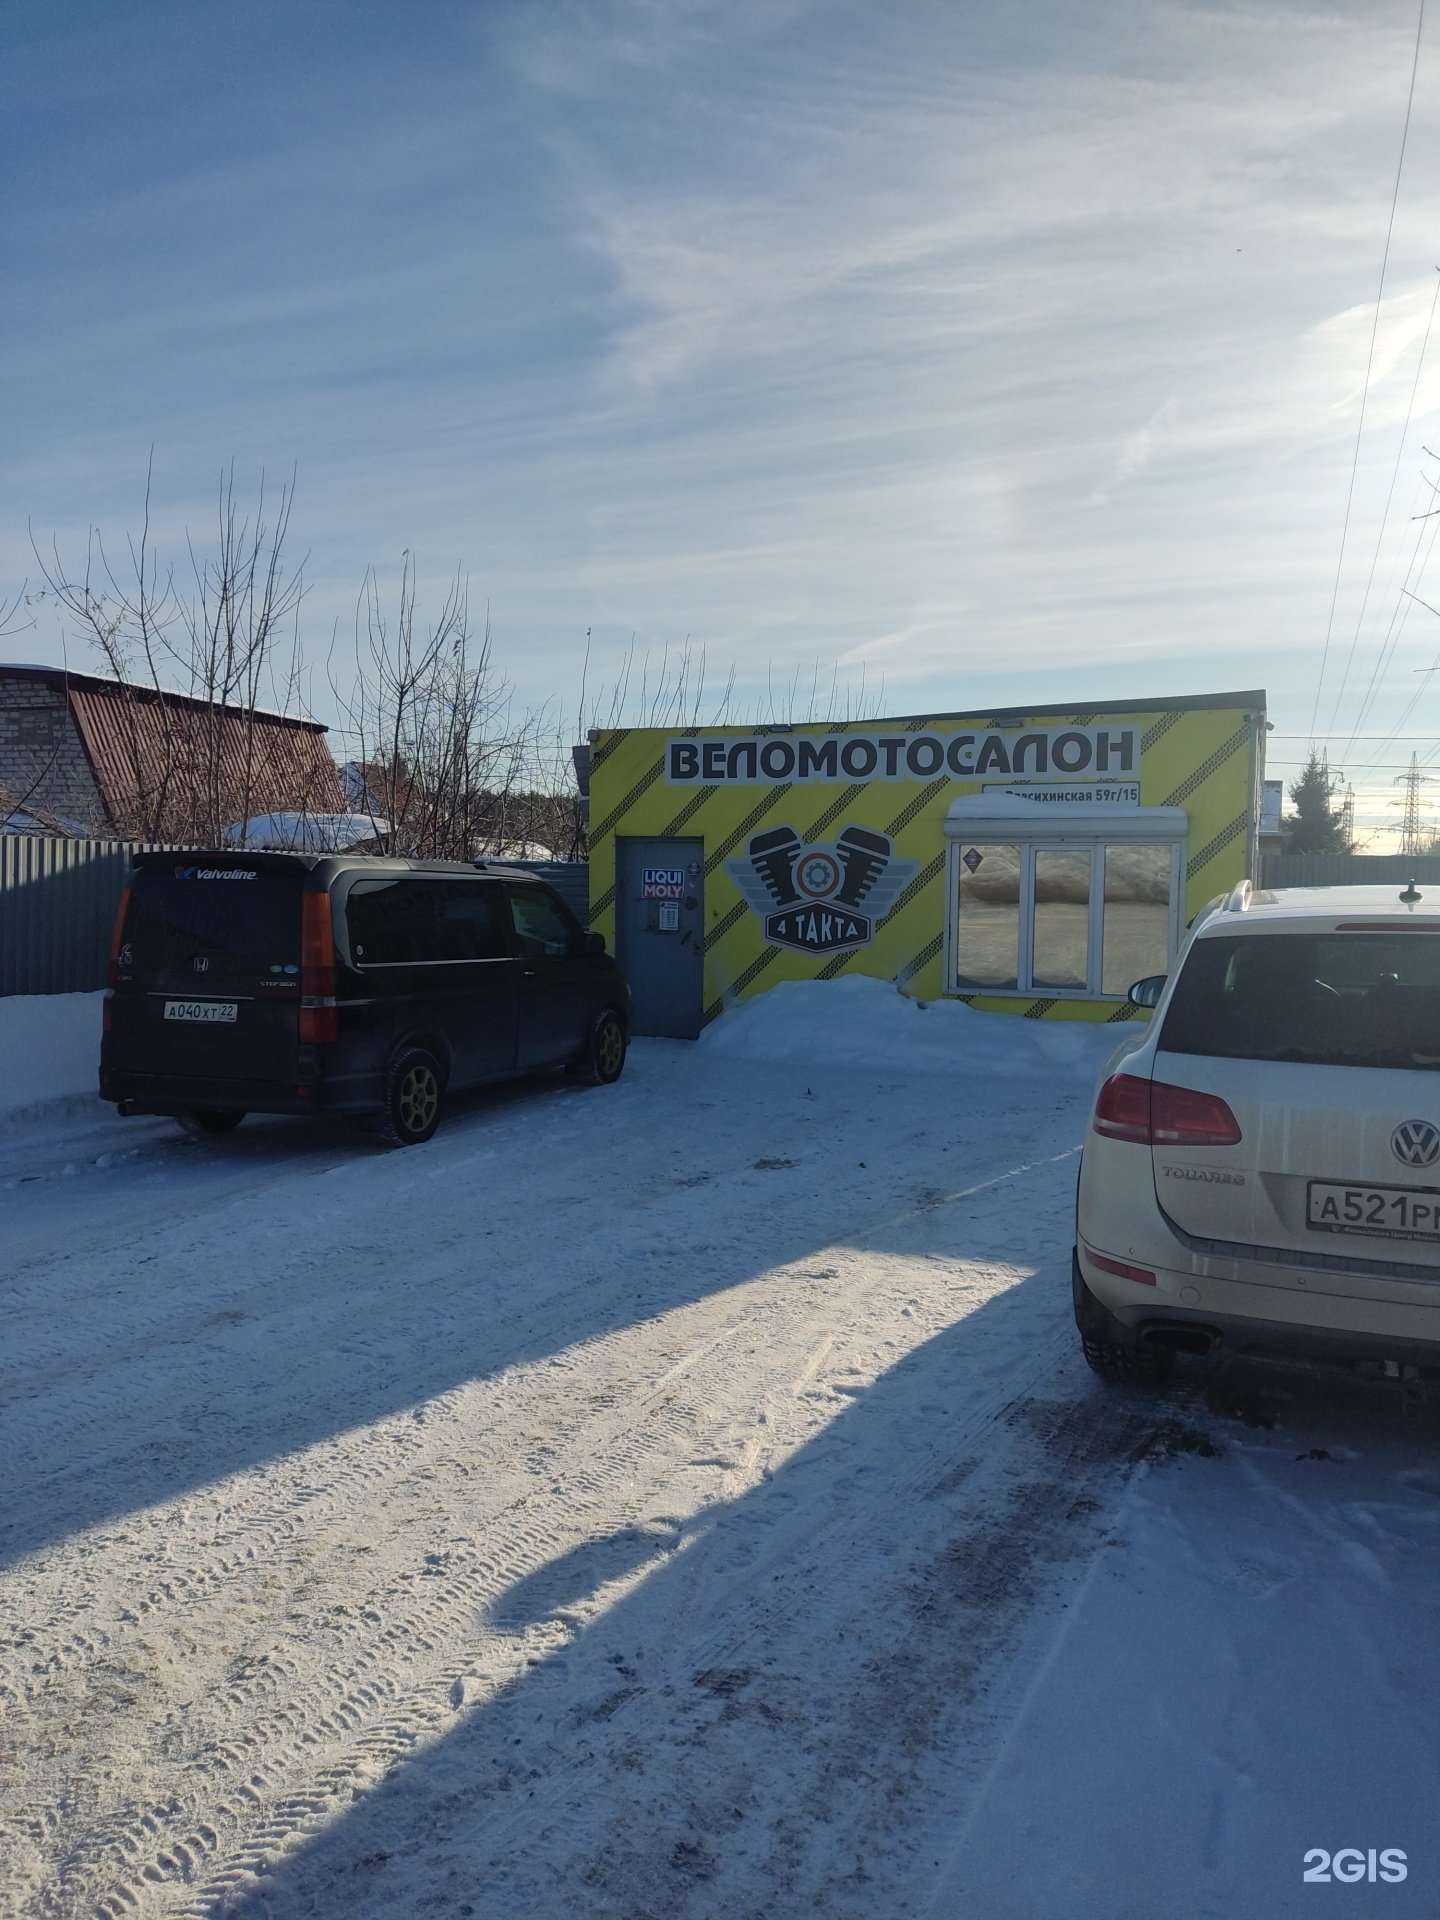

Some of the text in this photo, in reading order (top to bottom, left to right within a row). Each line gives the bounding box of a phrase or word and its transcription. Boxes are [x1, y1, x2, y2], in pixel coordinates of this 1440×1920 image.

[670, 730, 1133, 779] ВЕЛОМОТОСАЛОН
[1095, 788, 1137, 802] 59г/15
[197, 868, 257, 880] Valvoline
[644, 871, 682, 885] LIQUI
[644, 884, 683, 898] MOLY
[777, 911, 858, 943] 4 ТАКТА
[220, 1005, 234, 1017] 22
